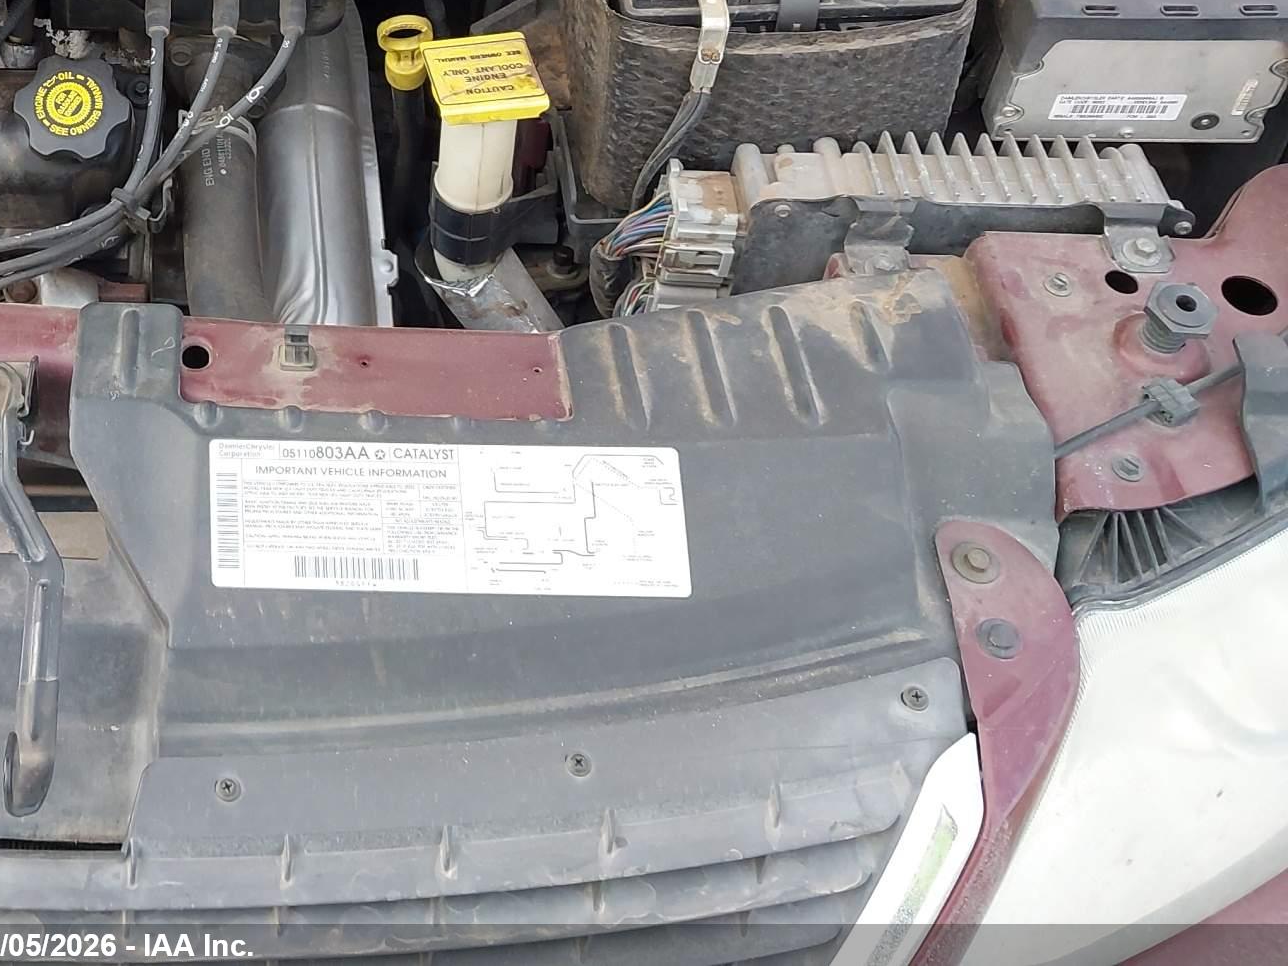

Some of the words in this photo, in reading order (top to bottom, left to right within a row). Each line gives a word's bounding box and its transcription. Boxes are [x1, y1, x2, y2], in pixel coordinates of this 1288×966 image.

[442, 68, 470, 76] ONLY
[474, 62, 524, 74] COOLANT
[464, 72, 506, 83] ENGINE
[465, 84, 514, 95] CAUTION
[34, 86, 48, 120] ENGINE
[56, 72, 74, 80] OIL
[48, 124, 70, 136] SEE
[70, 110, 102, 136] OWNERS
[86, 76, 104, 110] MANUAL
[282, 446, 370, 460] 05110803AA
[393, 448, 454, 460] CATALYST
[256, 466, 317, 476] IMPORTANT
[321, 467, 364, 477] VEHICLE
[367, 468, 447, 478] INFORMATION
